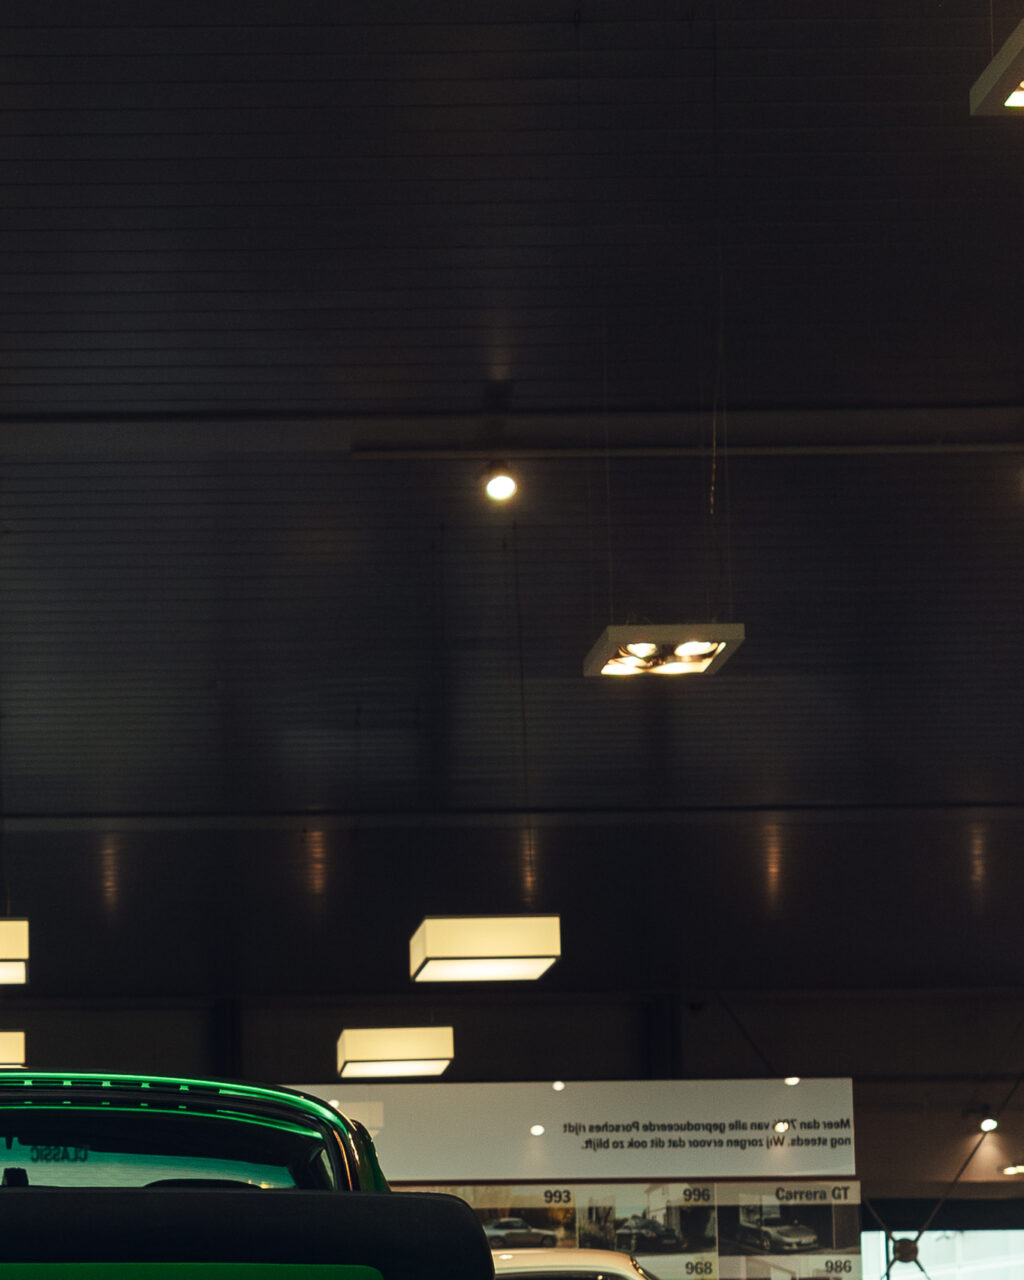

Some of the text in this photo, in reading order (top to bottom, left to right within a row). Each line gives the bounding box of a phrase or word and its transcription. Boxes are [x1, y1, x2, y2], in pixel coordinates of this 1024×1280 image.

[543, 1189, 572, 1204] 993
[682, 1188, 711, 1203] 996
[774, 1186, 851, 1202] Carrera GT
[684, 1261, 713, 1275] 968
[824, 1260, 852, 1274] 986
